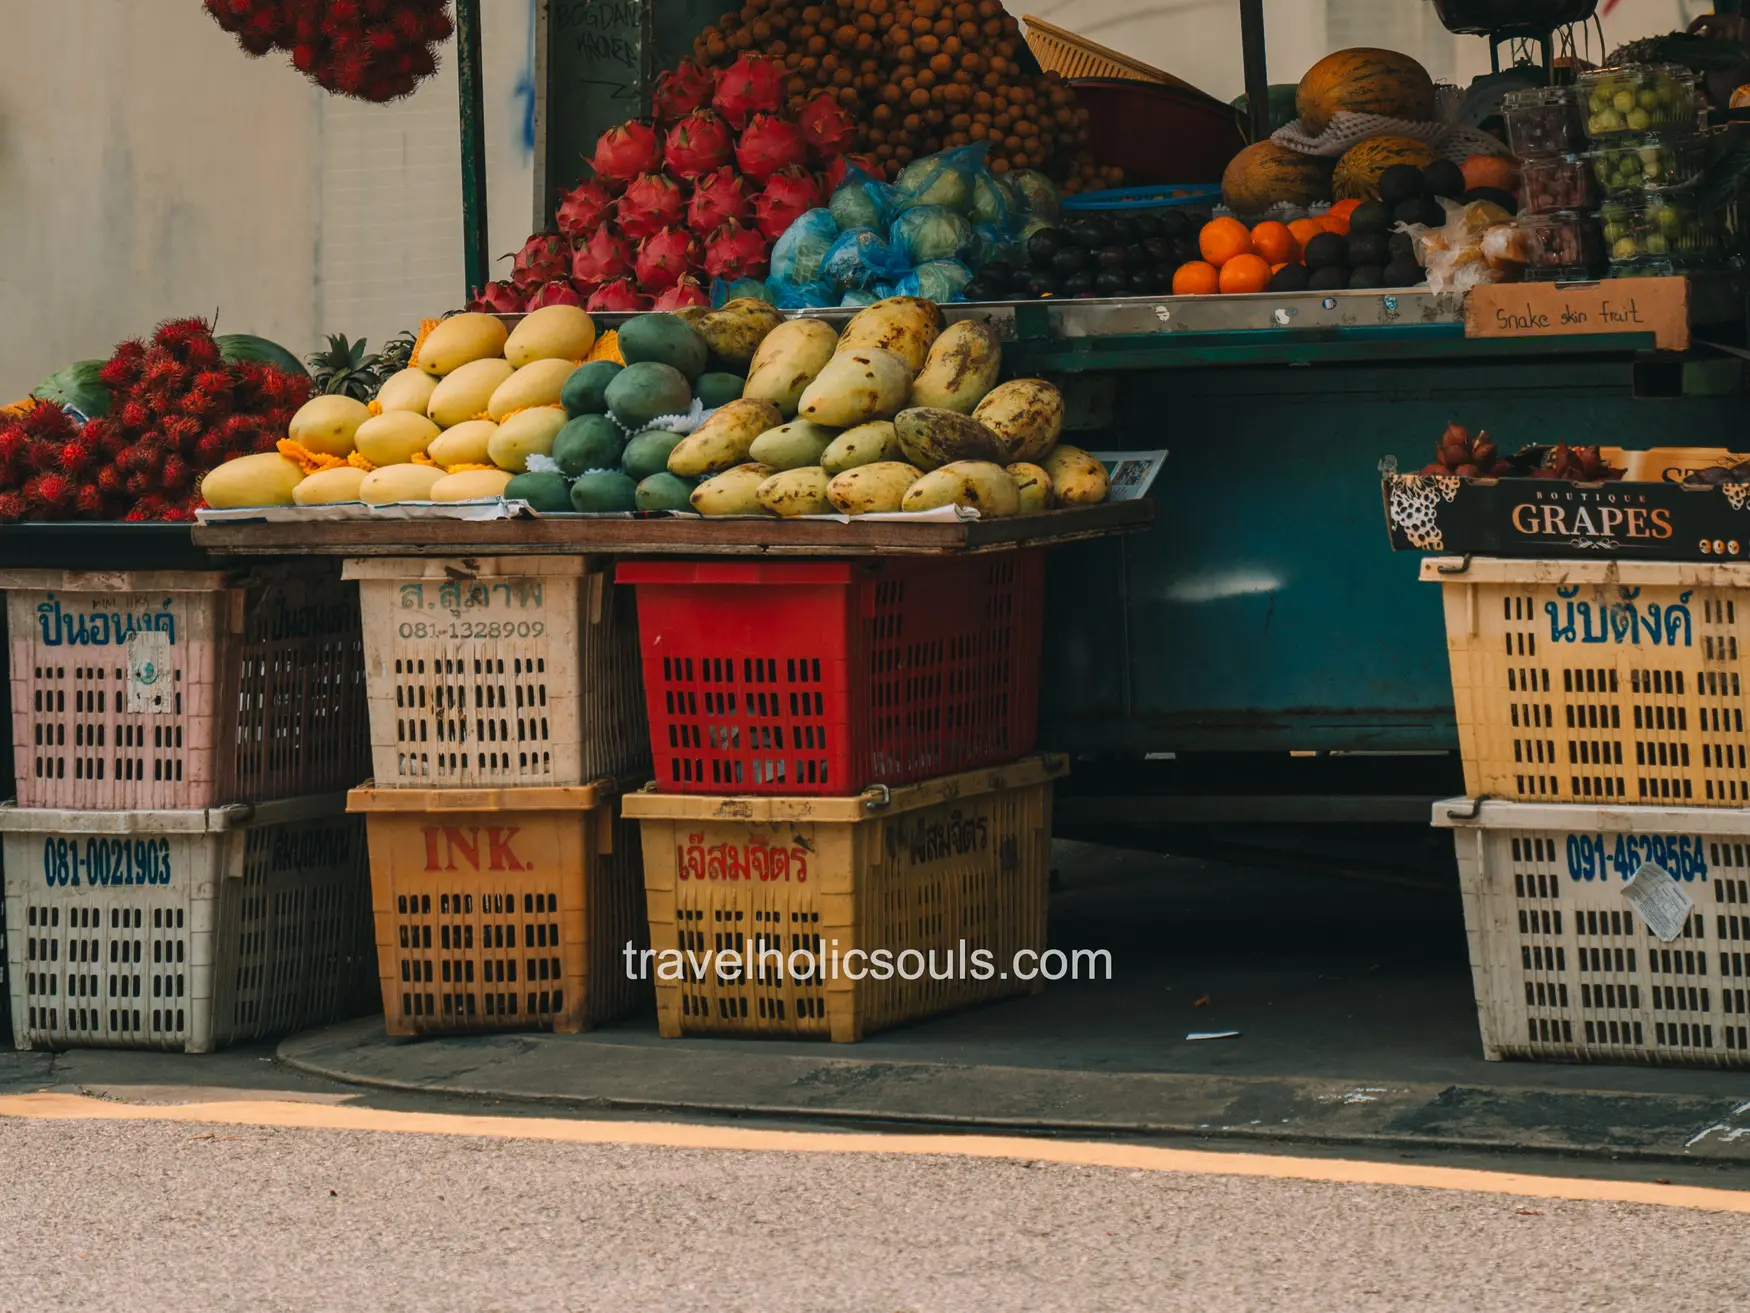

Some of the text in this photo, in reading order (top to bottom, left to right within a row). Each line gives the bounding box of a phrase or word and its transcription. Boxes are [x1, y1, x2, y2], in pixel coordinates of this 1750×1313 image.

[1495, 301, 1551, 331] Snake
[1560, 303, 1588, 326] skin
[1536, 491, 1647, 503] BOUTIQUE
[1511, 503, 1673, 540] GRAPES
[398, 620, 545, 640] 081-1328909
[44, 837, 171, 887] 081-0021903
[423, 825, 535, 873] INK.
